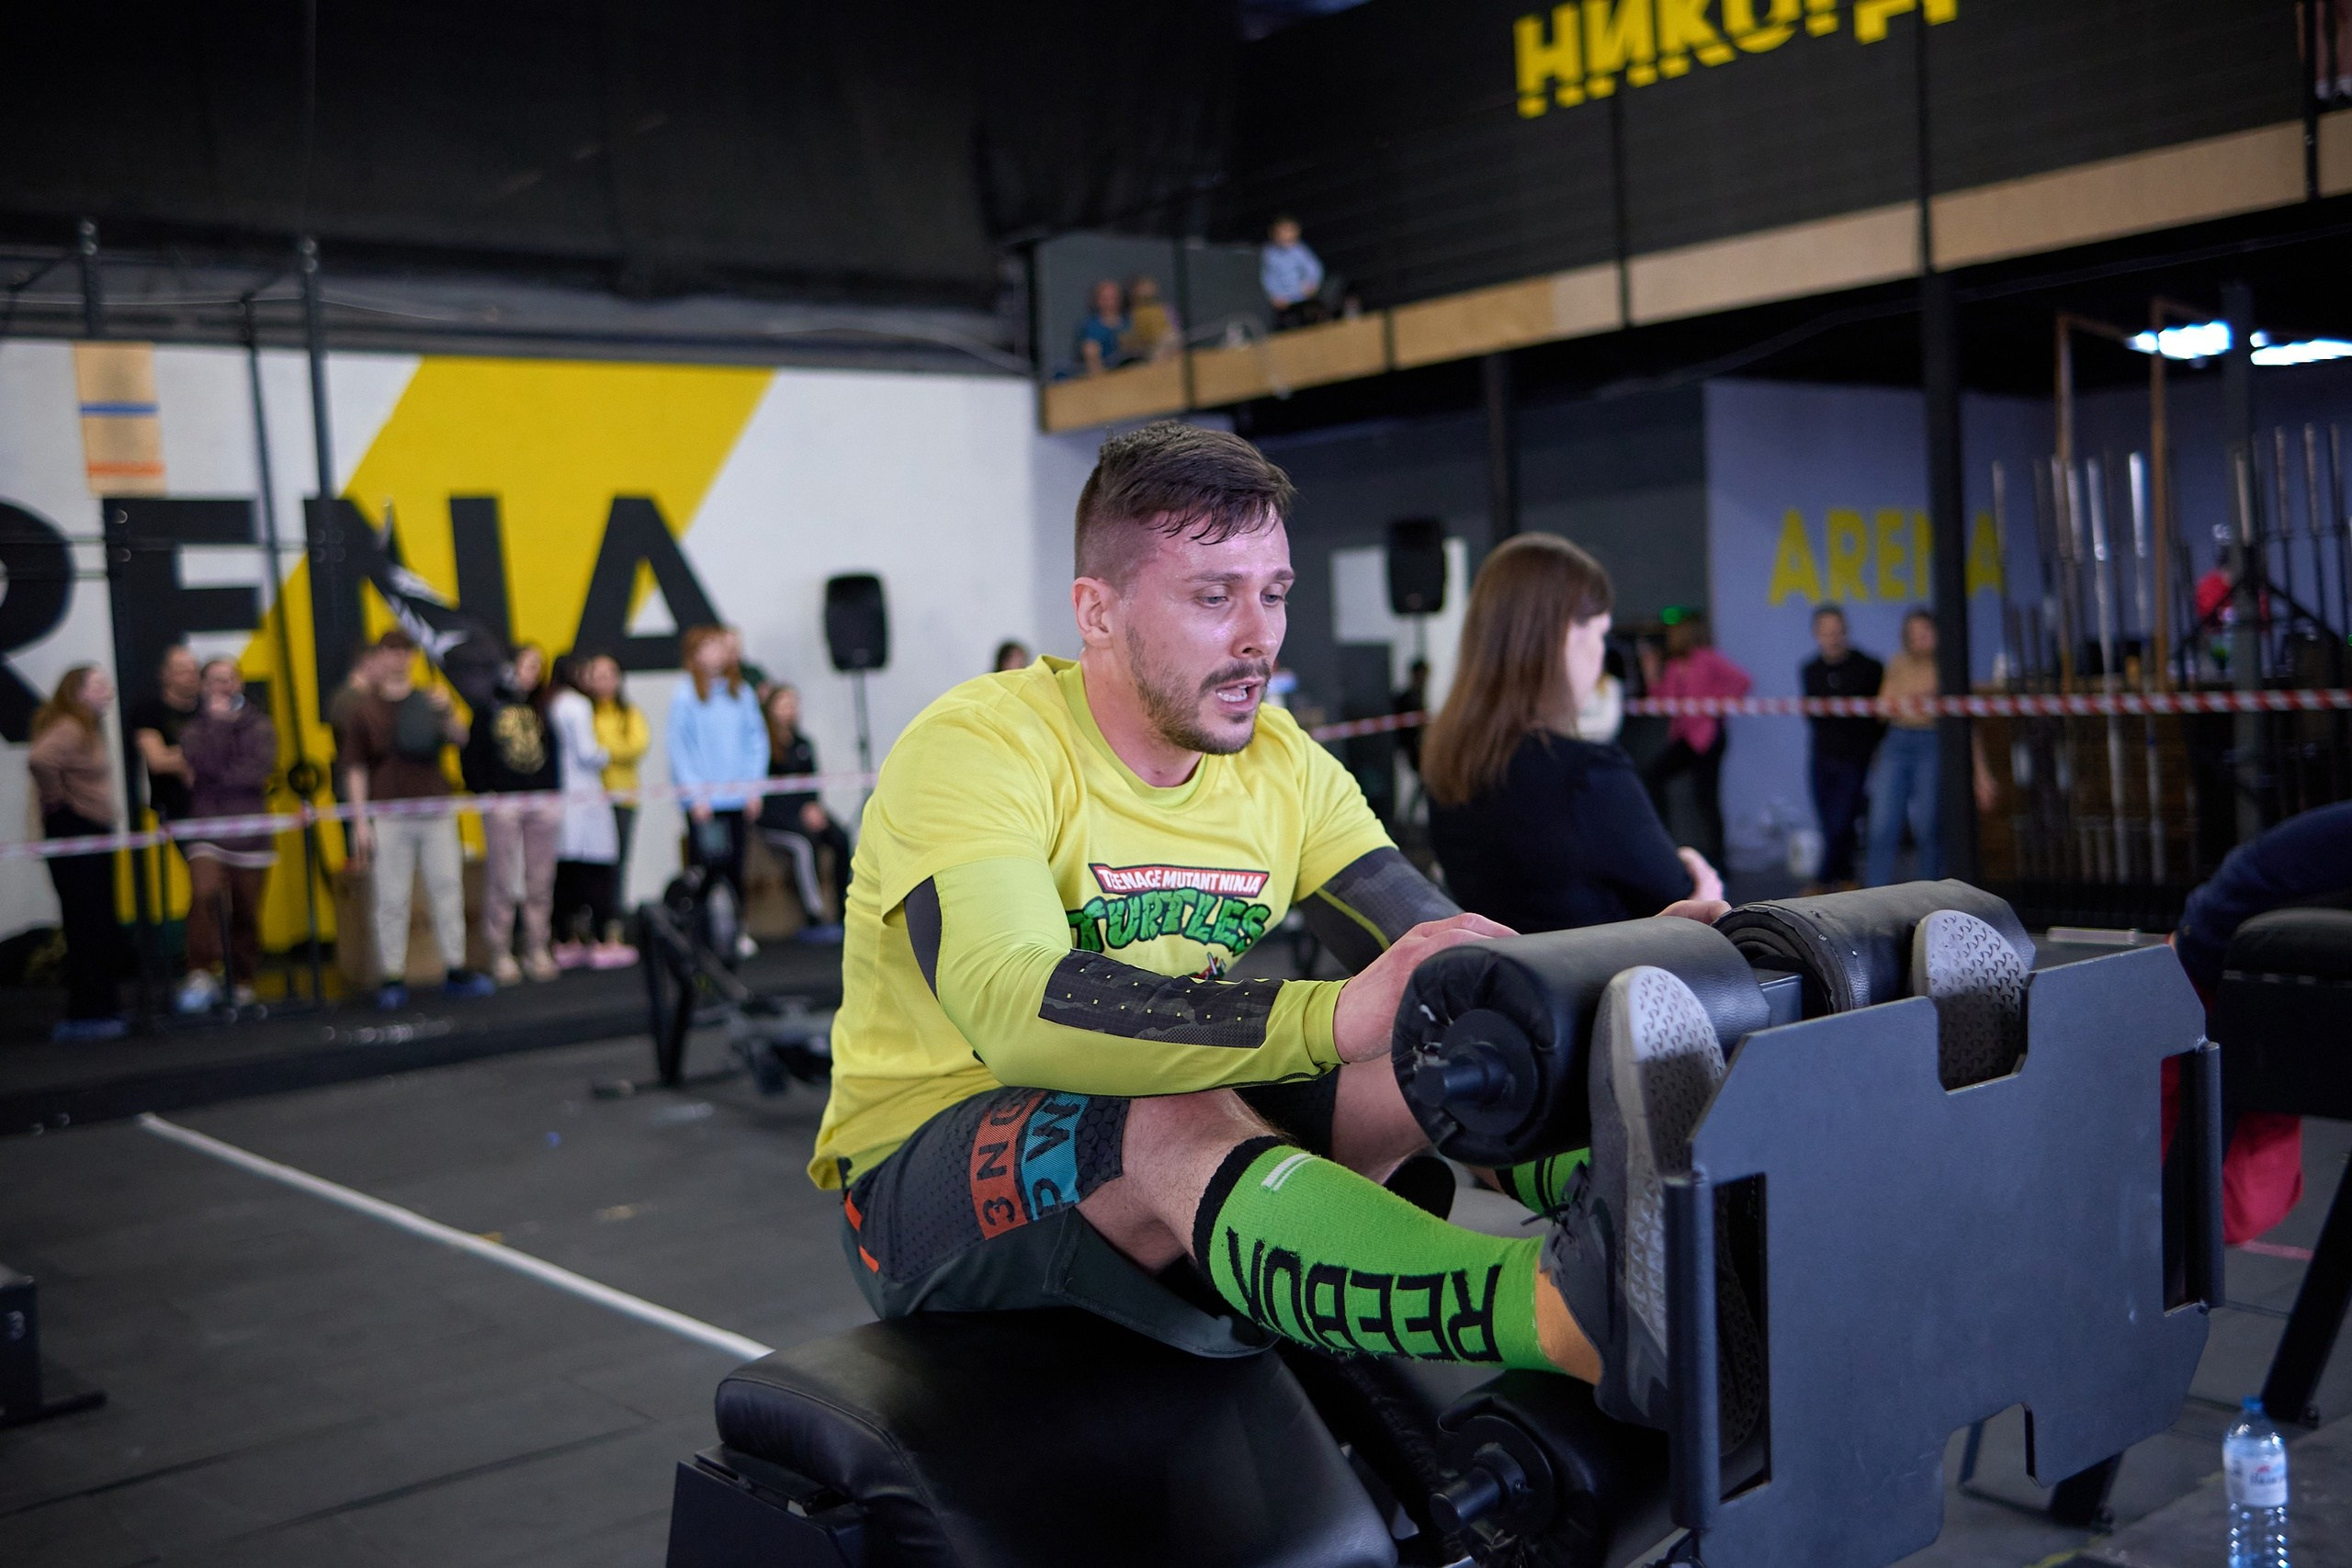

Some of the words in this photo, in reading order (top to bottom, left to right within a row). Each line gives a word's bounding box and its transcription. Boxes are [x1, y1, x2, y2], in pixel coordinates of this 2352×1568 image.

[1514, 0, 1959, 118] НИКО
[1098, 869, 1162, 890] TEENAGE
[1162, 870, 1220, 891] MUTANT
[1219, 874, 1262, 894] NINJA
[1066, 887, 1272, 956] TURTLES
